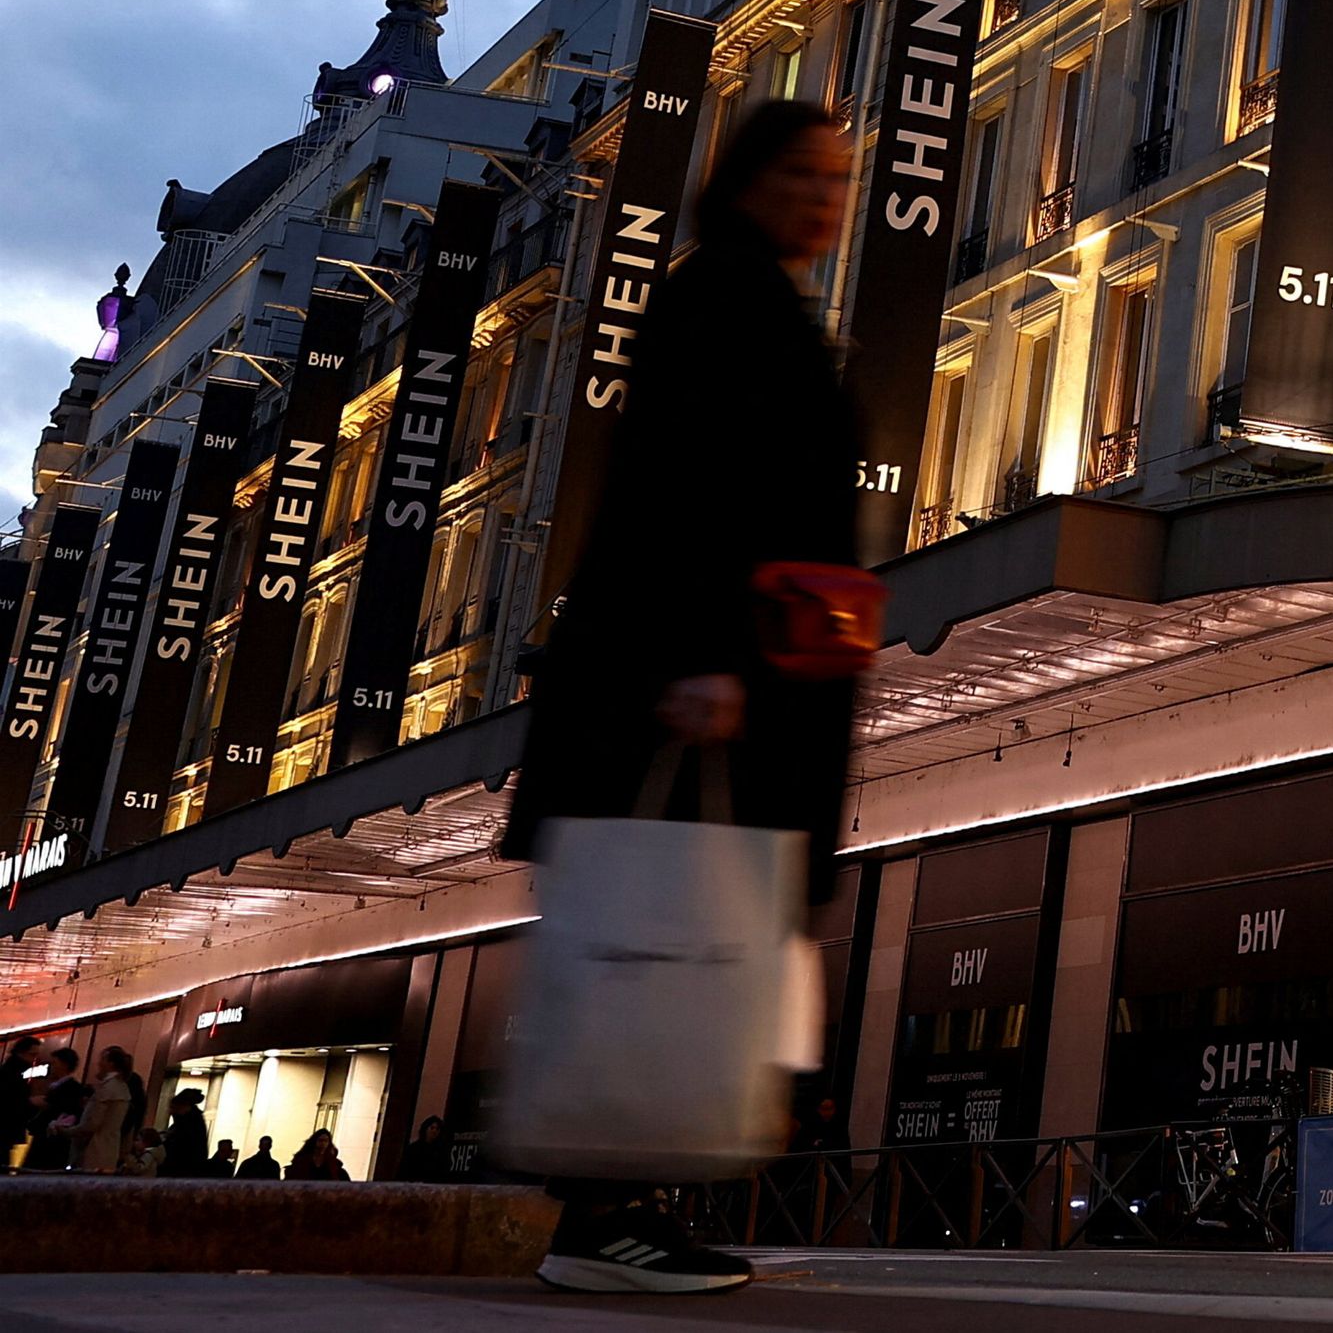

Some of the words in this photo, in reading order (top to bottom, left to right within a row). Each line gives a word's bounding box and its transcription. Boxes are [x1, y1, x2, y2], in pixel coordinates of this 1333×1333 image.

[643, 90, 688, 116] BHV
[437, 251, 478, 271] BHV
[586, 203, 667, 414] SHEIN
[308, 351, 344, 370] BHV
[203, 433, 237, 450] BHV
[385, 349, 457, 530] SHEIN
[855, 461, 902, 494] 5.11
[131, 487, 162, 502] BHV
[260, 440, 326, 603] SHEIN
[54, 547, 84, 562] BHV
[157, 514, 219, 661] SHEIN
[0, 599, 15, 611] HV
[87, 561, 146, 696] SHEIN
[9, 615, 67, 740] SHEIN
[353, 687, 393, 710] 5.11
[226, 744, 263, 764] 5.11
[123, 791, 158, 809] 5.11
[55, 816, 85, 832] 5.11
[1237, 908, 1286, 955] BHV
[951, 947, 988, 987] BHV
[1200, 1039, 1299, 1092] SHEIN
[964, 1098, 1001, 1120] OFFERT
[895, 1113, 940, 1139] SHEIN
[968, 1119, 998, 1143] BHV
[450, 1145, 478, 1171] SHE
